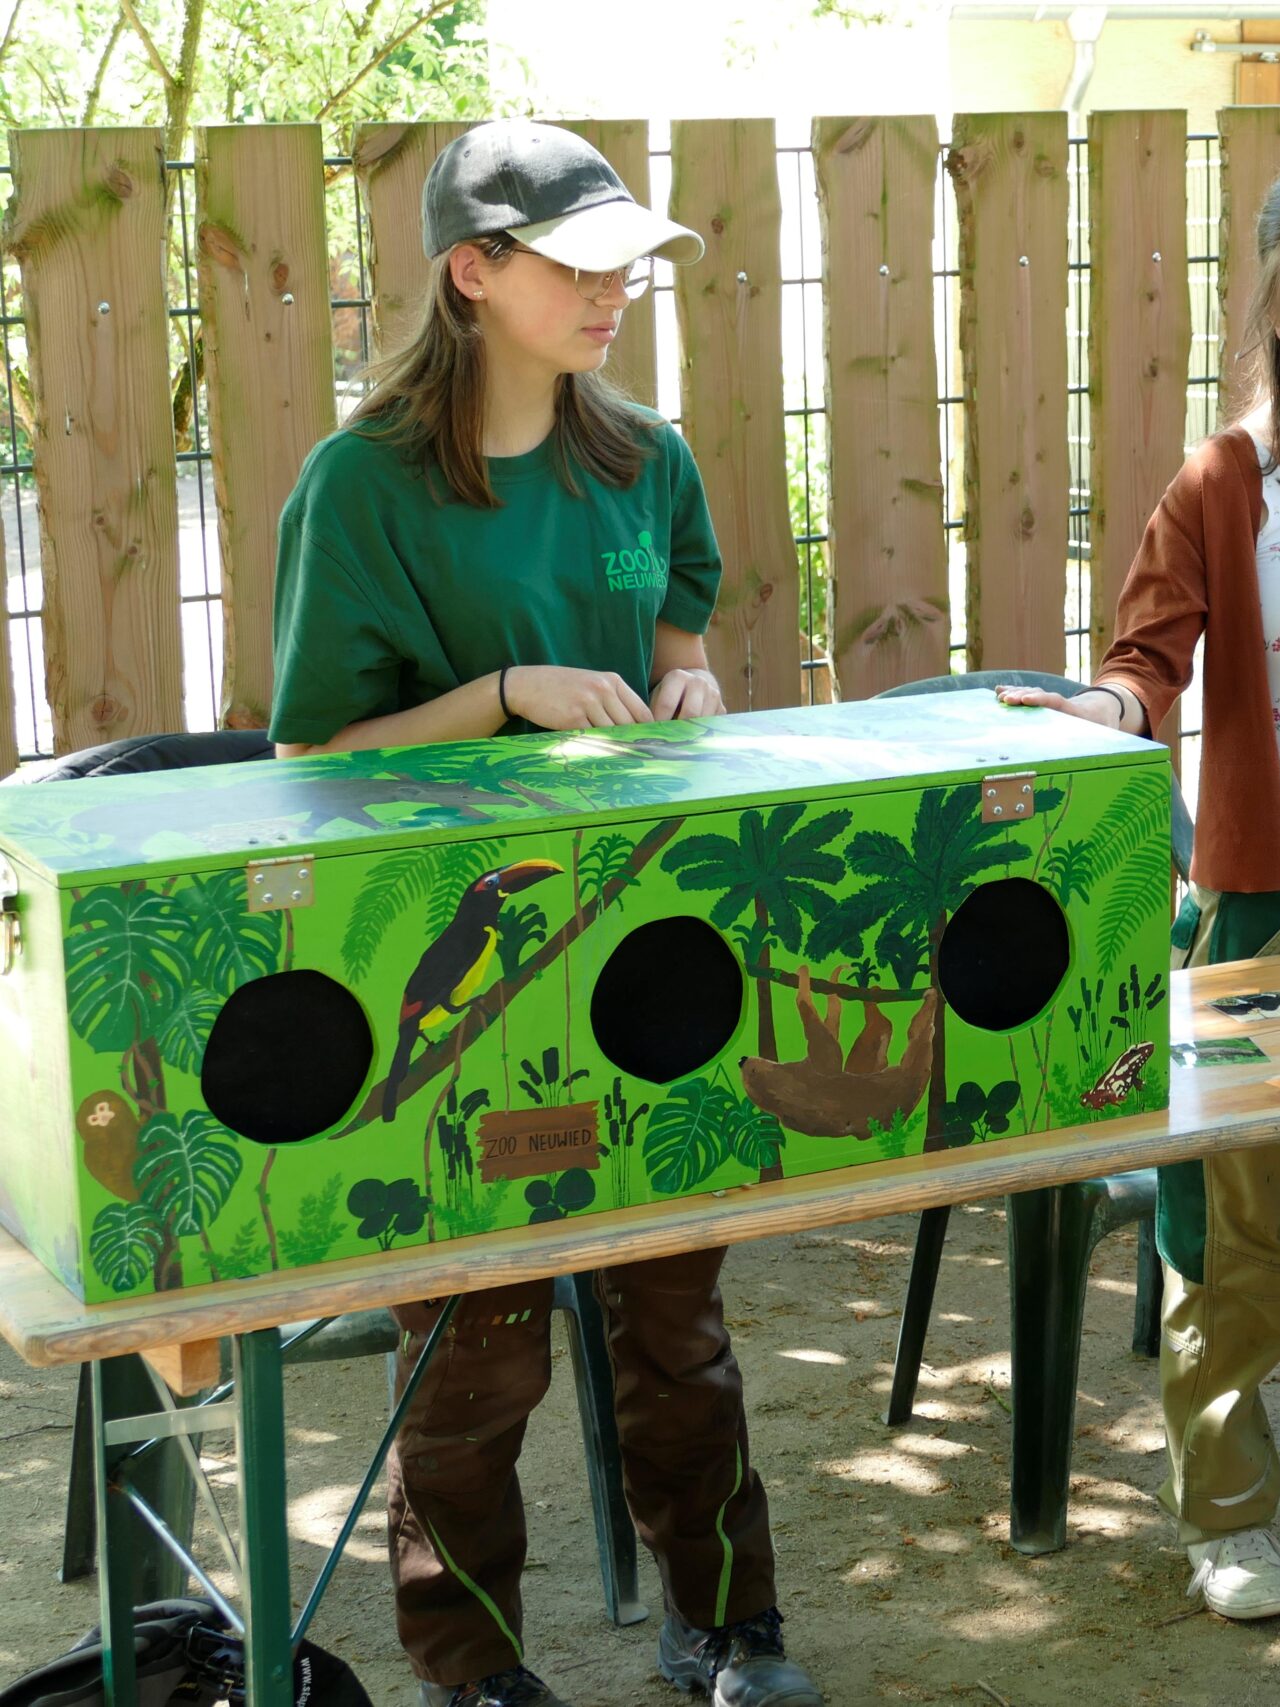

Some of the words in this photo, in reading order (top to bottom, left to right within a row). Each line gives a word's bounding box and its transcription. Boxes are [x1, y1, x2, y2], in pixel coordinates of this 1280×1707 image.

[601, 549, 650, 576] ZOO
[485, 1136, 517, 1159] ZOO
[528, 1128, 592, 1153] NEUWIED
